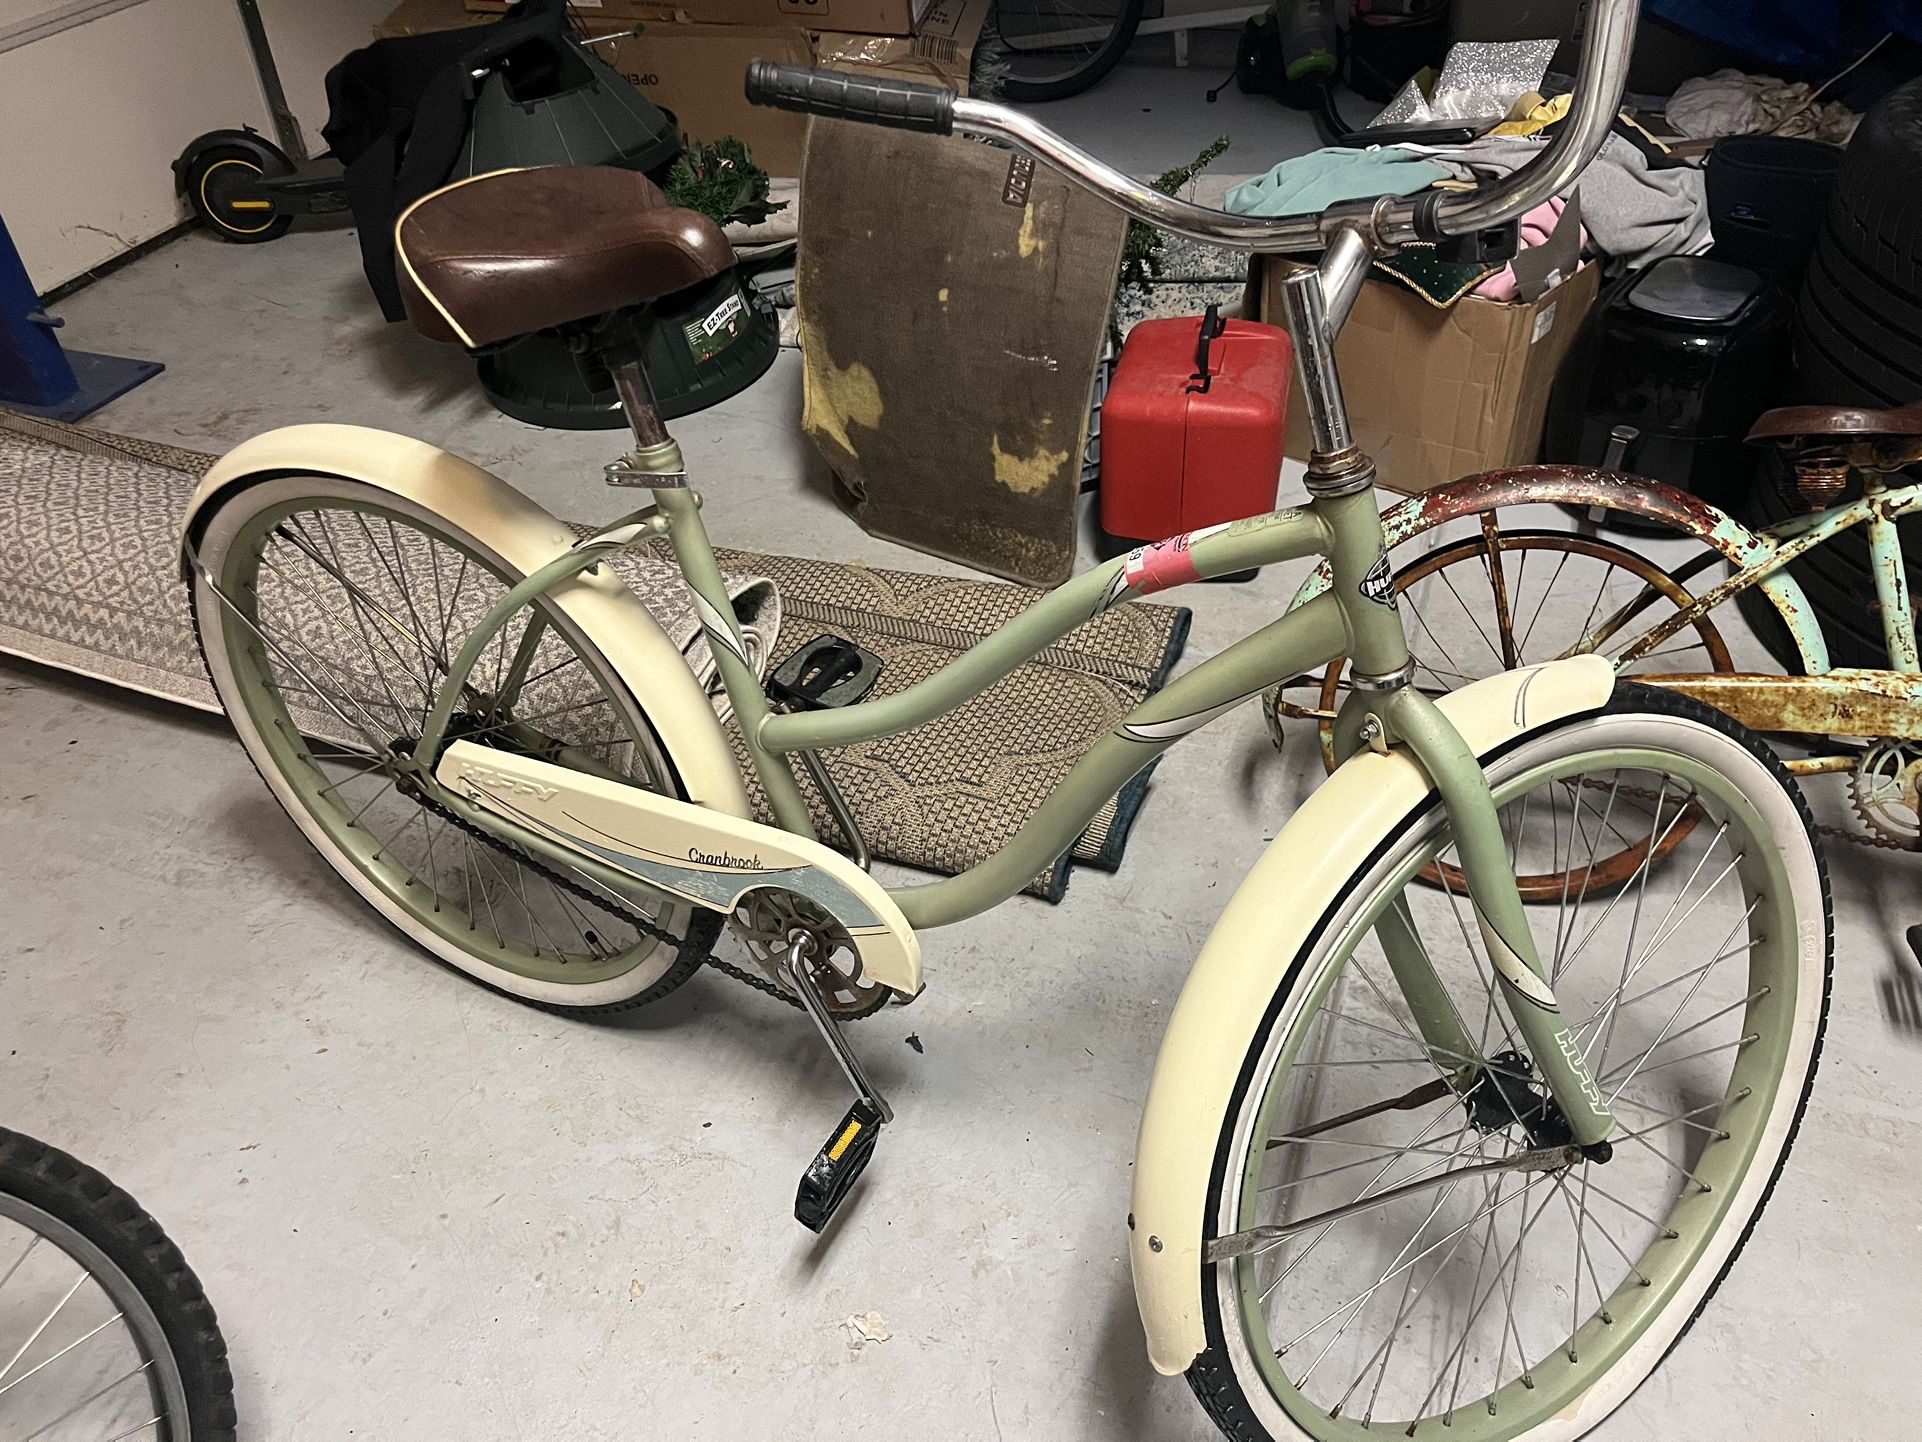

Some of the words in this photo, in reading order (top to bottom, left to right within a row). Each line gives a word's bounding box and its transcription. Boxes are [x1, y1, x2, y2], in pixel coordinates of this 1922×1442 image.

[1366, 573, 1392, 597] HU
[461, 762, 559, 802] HUFFY
[688, 847, 764, 871] Cranbrook
[1553, 1027, 1612, 1116] HUFFY
